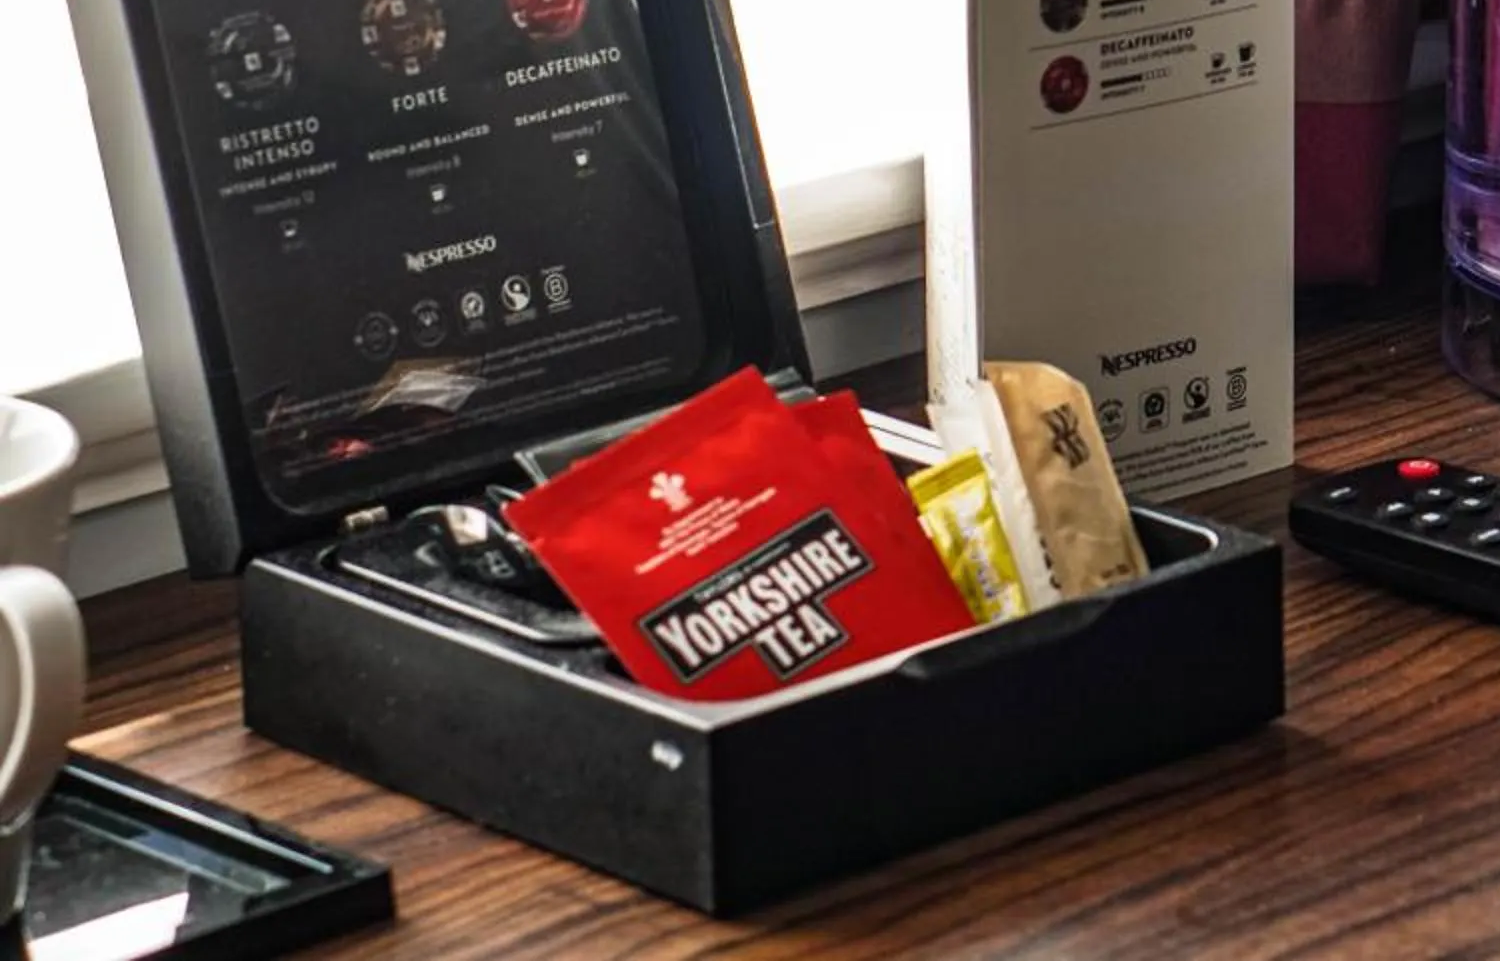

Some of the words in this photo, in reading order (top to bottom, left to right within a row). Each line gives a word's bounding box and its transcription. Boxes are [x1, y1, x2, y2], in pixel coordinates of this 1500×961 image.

[1100, 26, 1195, 55] DECAFFEINATO
[506, 46, 622, 87] DECAFFEINATO
[391, 86, 449, 114] FORTE
[514, 110, 548, 127] DENSE
[551, 104, 572, 119] AND
[574, 92, 632, 112] POWERFUL
[219, 116, 320, 153] RISTRETTO
[409, 139, 432, 153] AND
[434, 124, 491, 147] BALANCED
[233, 138, 315, 171] INTENSO
[404, 234, 498, 273] NESPRESSO
[1098, 337, 1198, 377] NESPRESSO
[654, 528, 863, 668] YORKSHIRE
[754, 603, 839, 668] TEA
